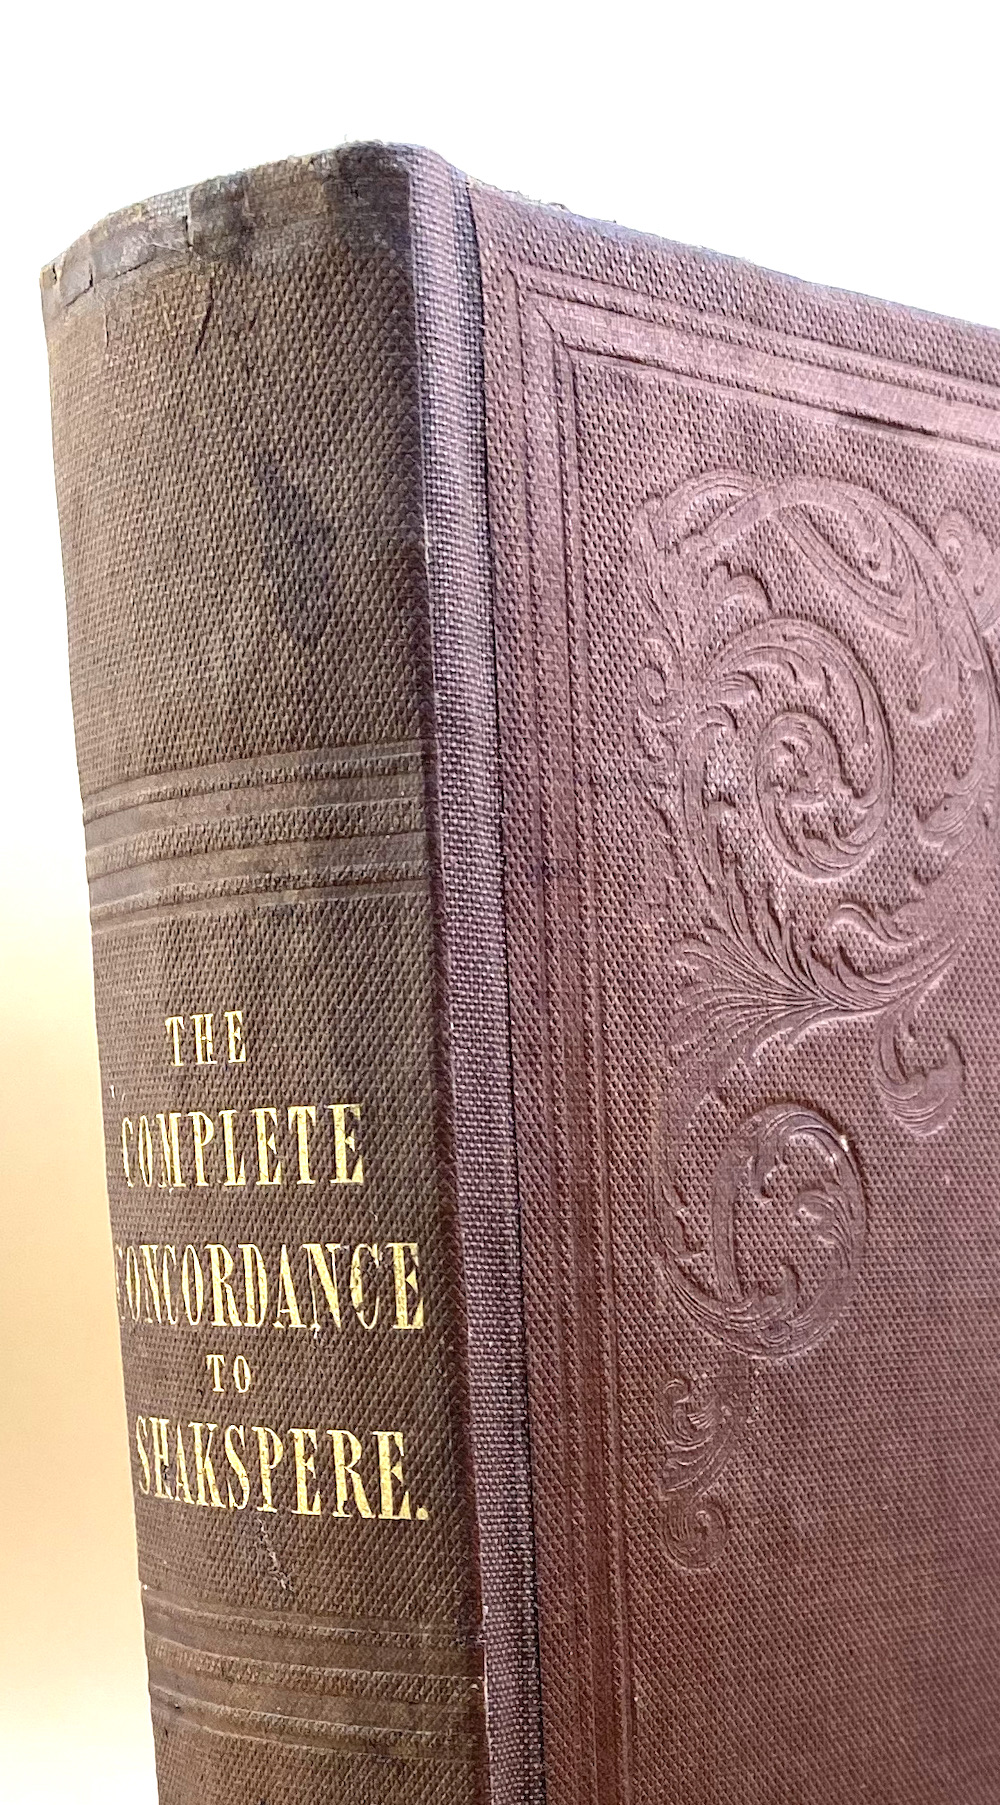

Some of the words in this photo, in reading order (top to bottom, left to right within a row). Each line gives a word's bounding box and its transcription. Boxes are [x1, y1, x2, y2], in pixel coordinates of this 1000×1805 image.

[165, 1010, 246, 1067] THE
[121, 1103, 364, 1187] COMPLETE
[206, 1354, 251, 1393] TO
[136, 1415, 429, 1520] SHAKSPERE.
